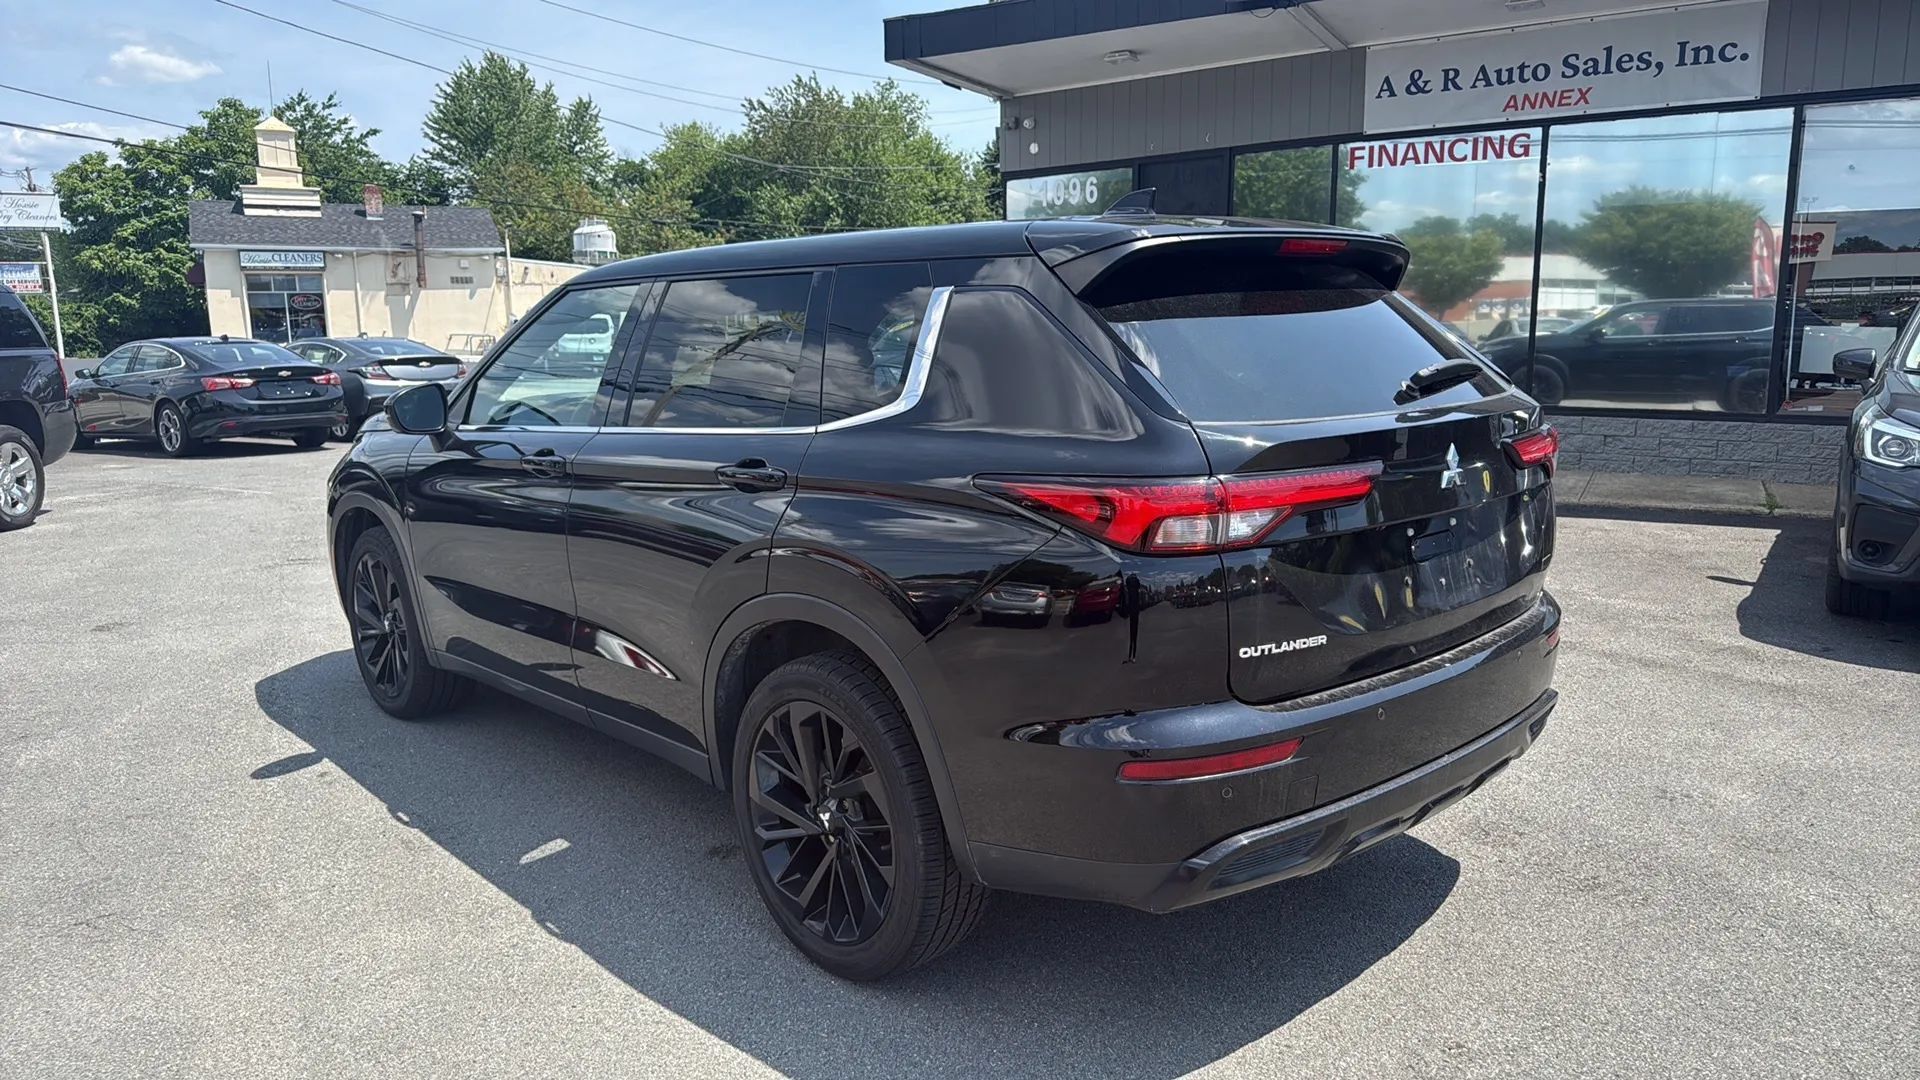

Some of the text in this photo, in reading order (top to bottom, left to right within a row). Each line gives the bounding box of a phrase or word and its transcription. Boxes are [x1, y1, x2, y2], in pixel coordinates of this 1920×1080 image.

[1375, 40, 1750, 99] A & R Auto Sales, Inc.
[1502, 86, 1594, 113] ANNEX
[1348, 133, 1532, 170] FINANCING
[1041, 176, 1098, 207] 1096
[15, 208, 57, 221] Cleaners
[271, 253, 323, 263] CLEANERS
[1238, 634, 1328, 659] OUTLANDER
